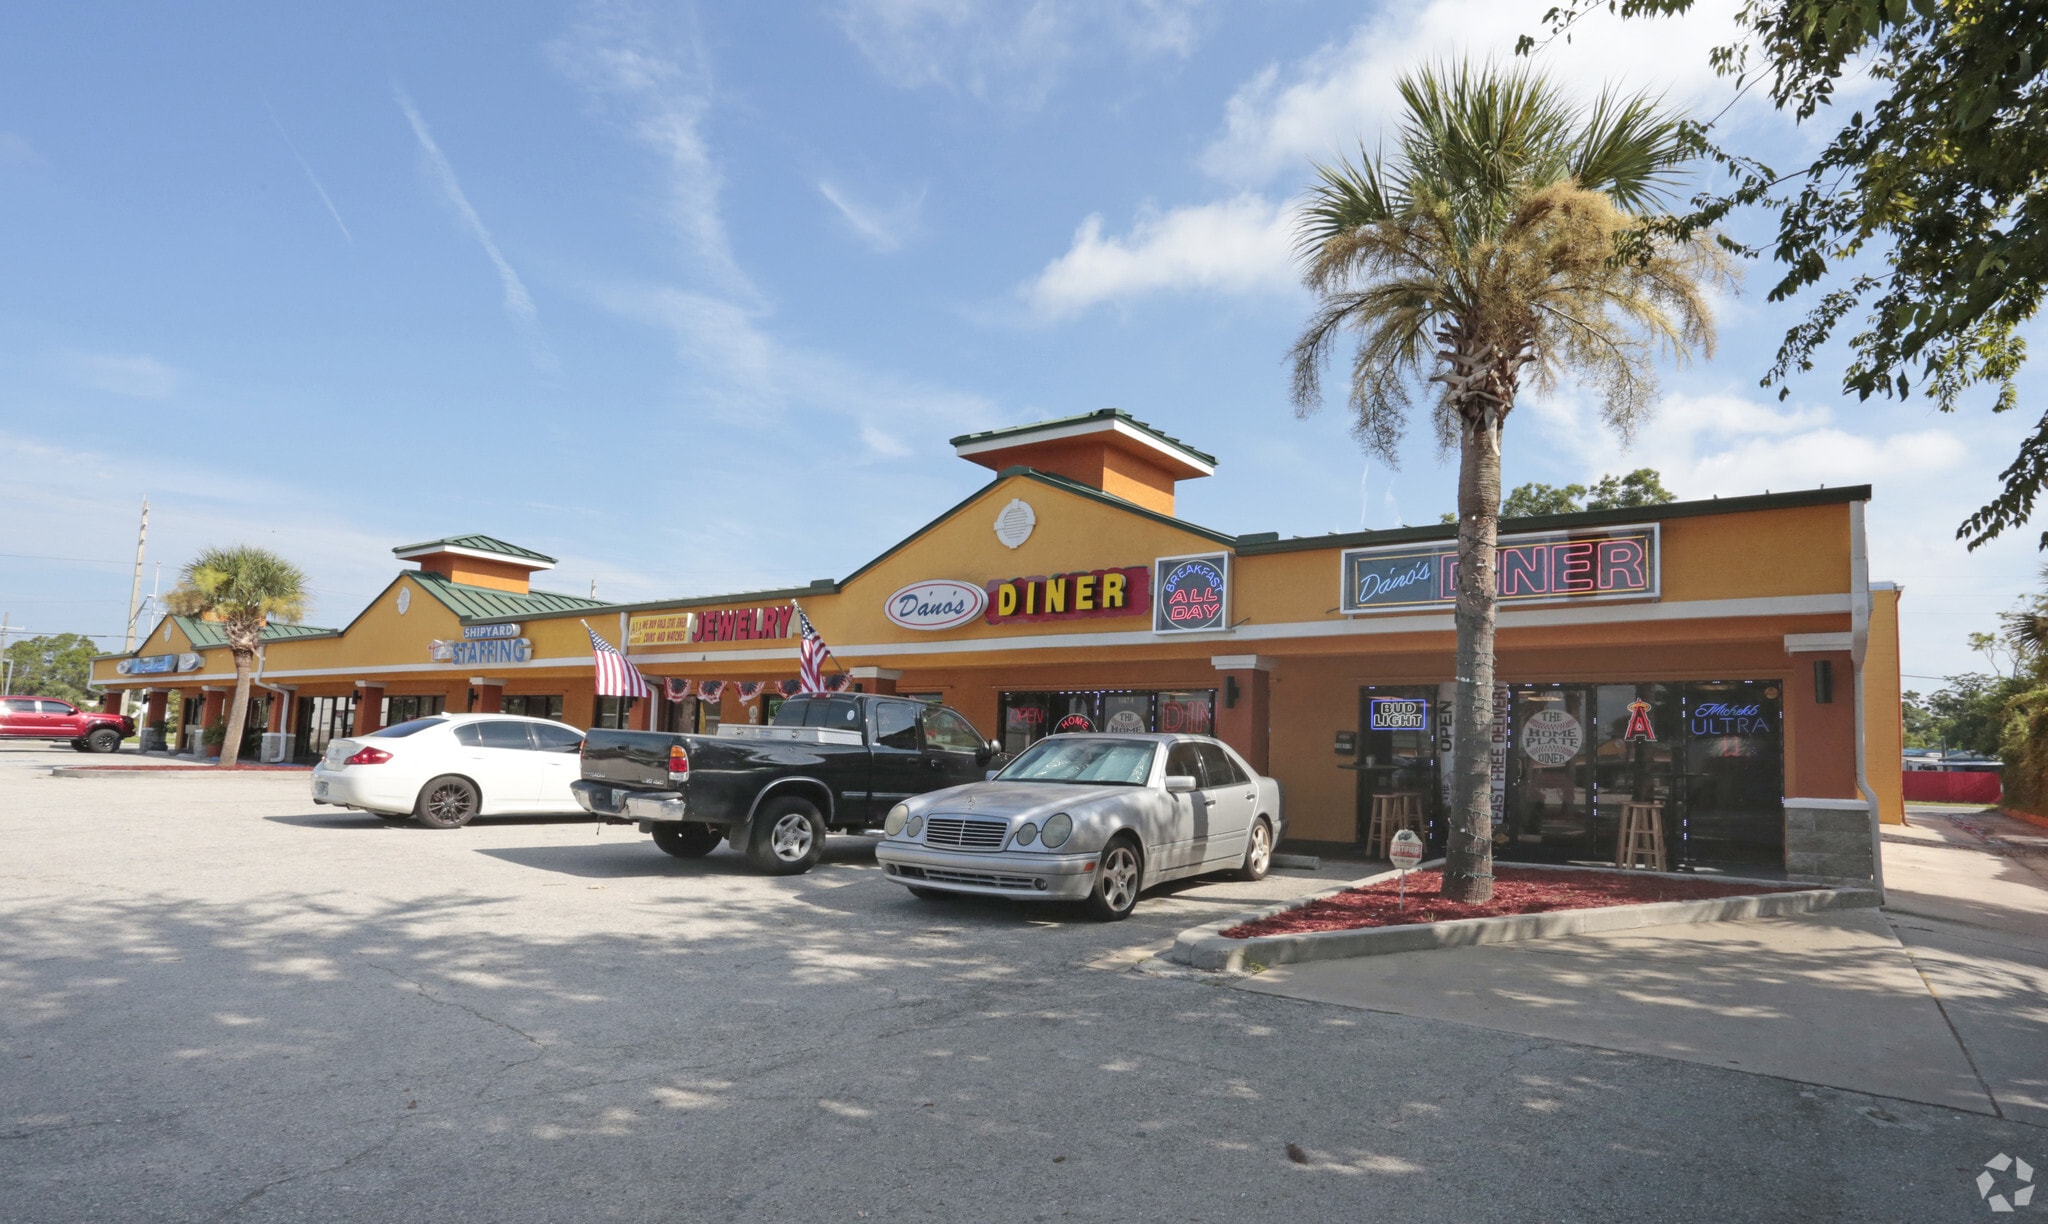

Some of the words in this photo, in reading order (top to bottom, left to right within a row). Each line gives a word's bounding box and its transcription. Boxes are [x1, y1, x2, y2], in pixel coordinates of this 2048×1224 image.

[1165, 564, 1223, 592] BREAKFAST
[1440, 540, 1645, 599] NER
[998, 573, 1124, 616] DINER
[1169, 587, 1218, 604] ALL
[1171, 603, 1220, 620] DAY
[464, 625, 513, 638] SHIPYARD
[692, 605, 795, 642] JEWELRY
[453, 638, 525, 664] STAFFING
[1009, 706, 1045, 724] OPEN
[1120, 712, 1135, 722] THE
[1381, 702, 1417, 715] BUD
[1492, 685, 1507, 743] DELIVERY
[1541, 711, 1563, 722] THE
[1061, 715, 1090, 730] HOME
[1374, 713, 1422, 727] LIGHT
[1439, 701, 1453, 752] OPEN
[1691, 717, 1770, 735] ULTRA
[1111, 725, 1143, 734] HOME
[1529, 727, 1577, 738] HOME
[1525, 737, 1579, 748] PLATE
[1490, 748, 1505, 782] FREE
[1538, 753, 1566, 764] DINER
